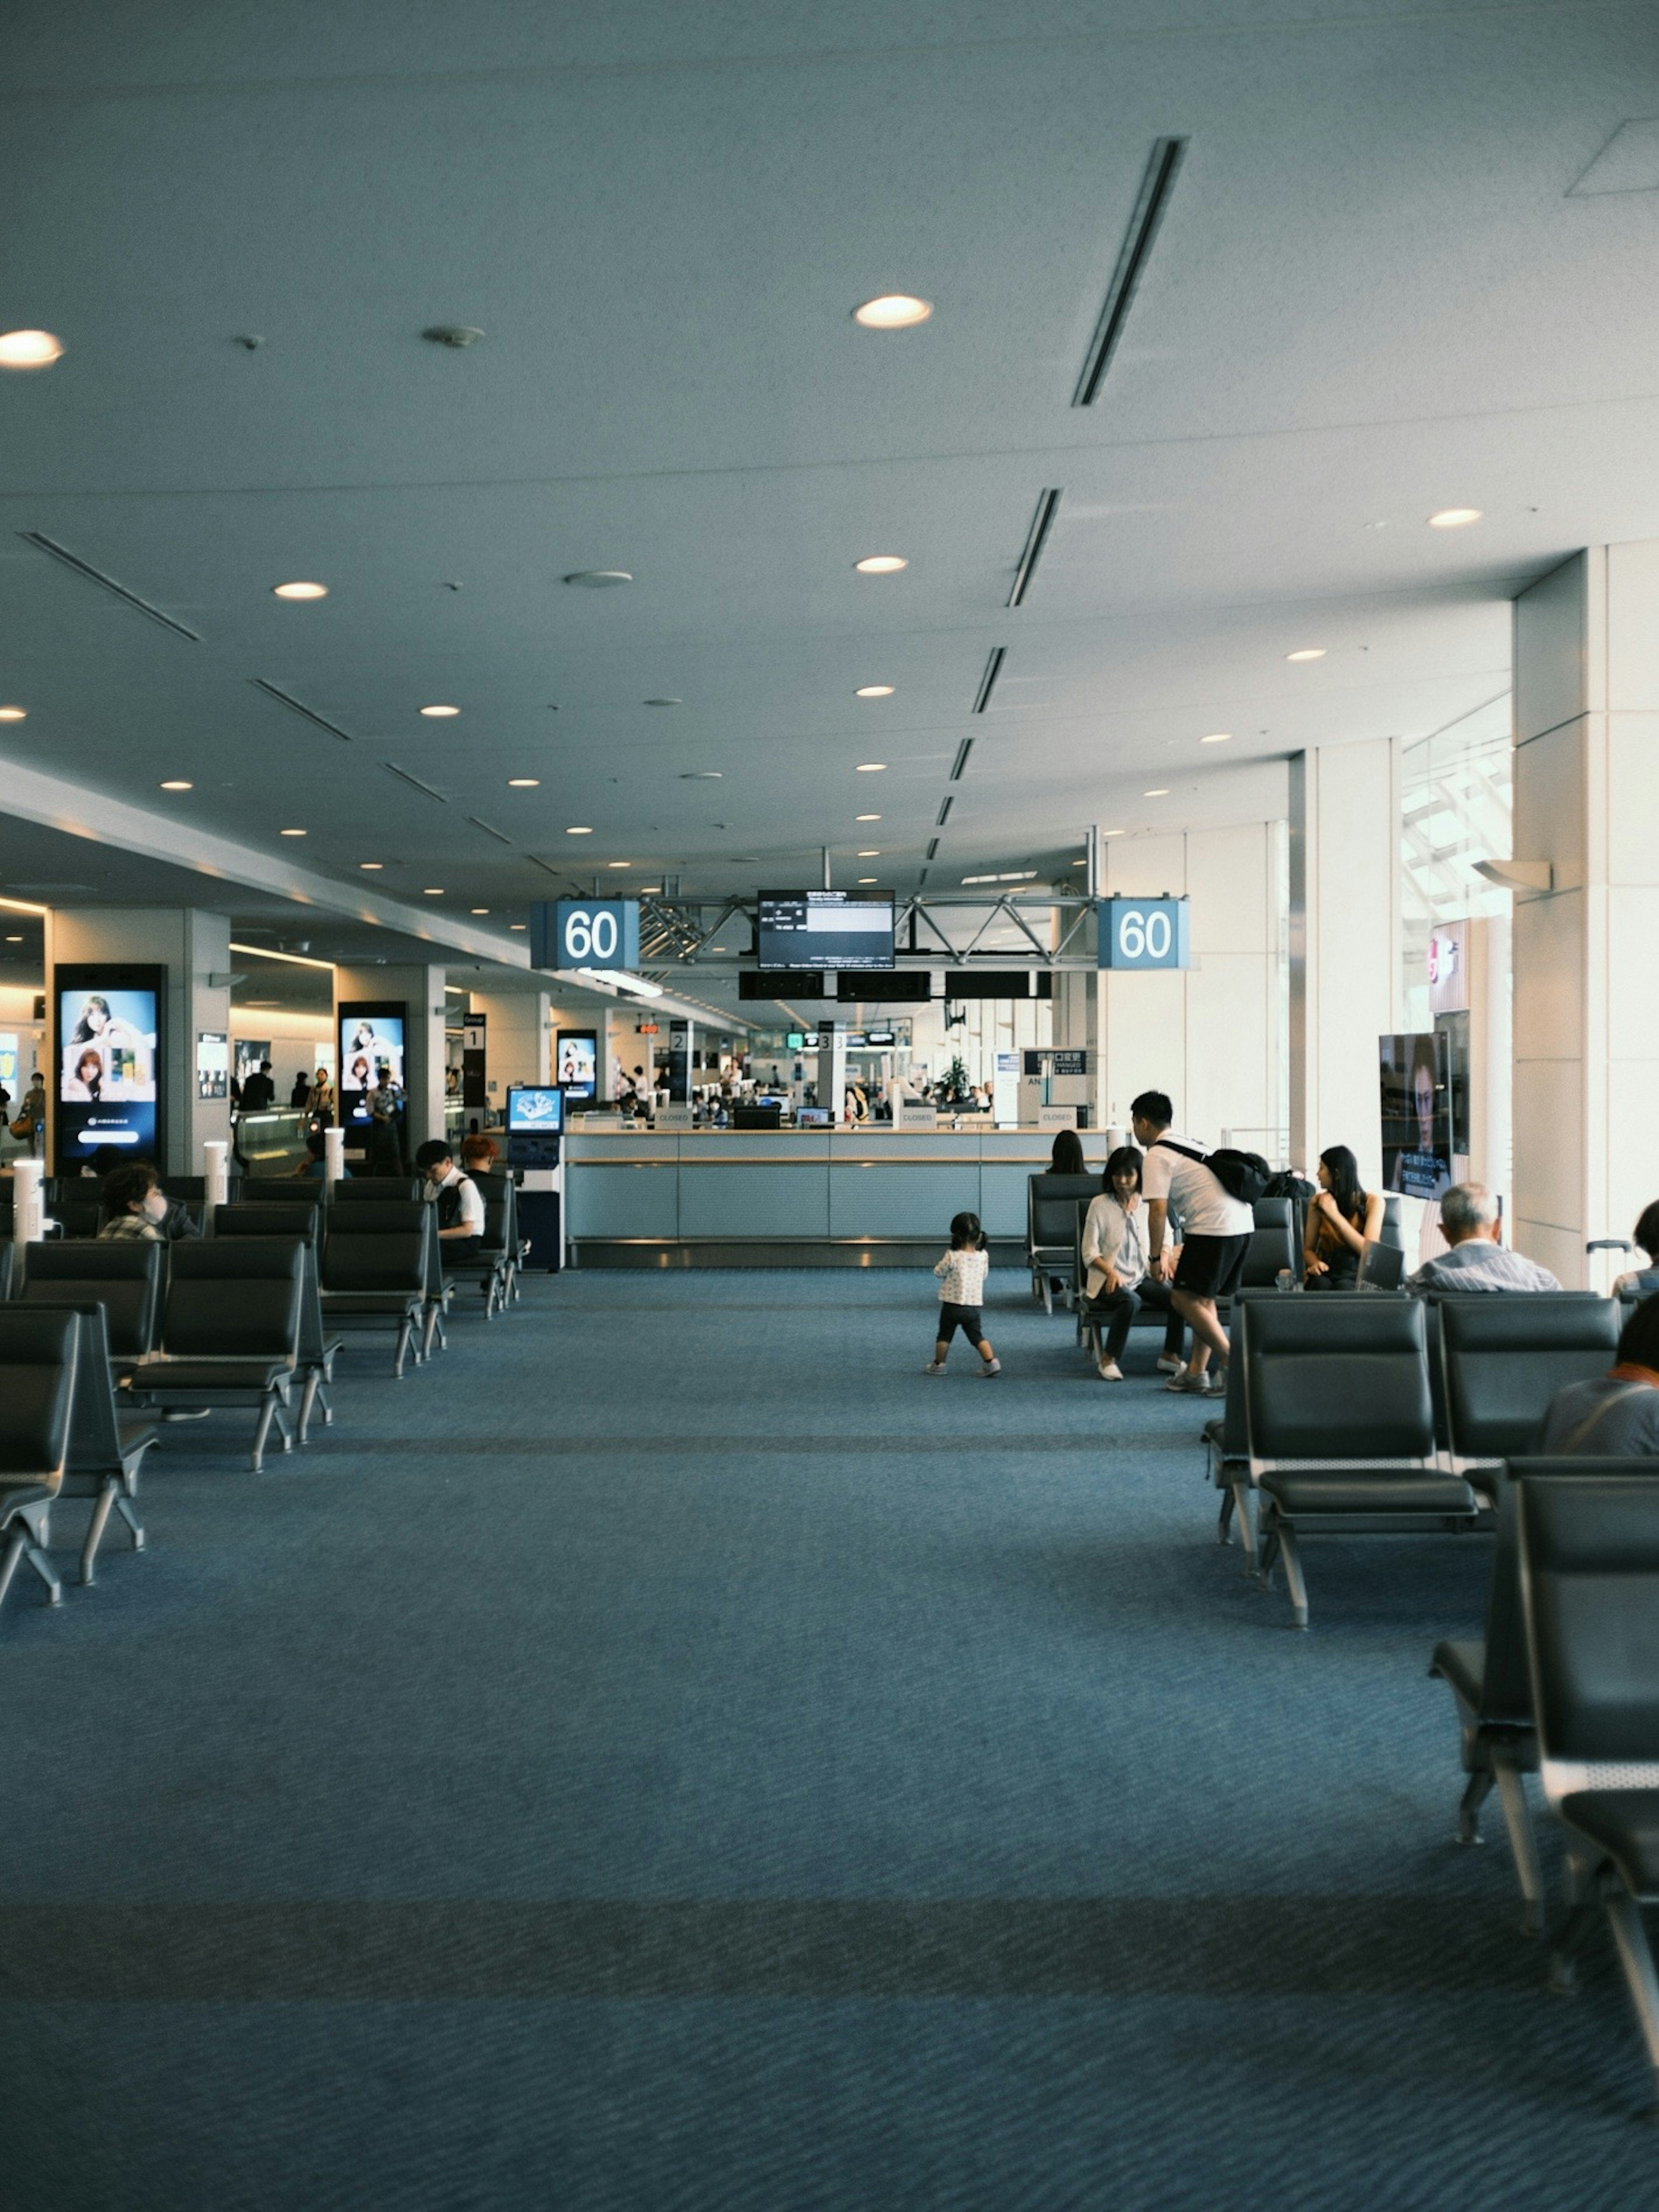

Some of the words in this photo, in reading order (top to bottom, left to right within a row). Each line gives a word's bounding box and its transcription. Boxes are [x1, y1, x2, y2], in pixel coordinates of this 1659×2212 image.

[566, 910, 617, 959] 60
[1120, 911, 1171, 958] 60
[470, 1031, 476, 1045] 1
[675, 1035, 683, 1048] 2
[822, 1036, 829, 1048] 3
[837, 1036, 842, 1048] 3
